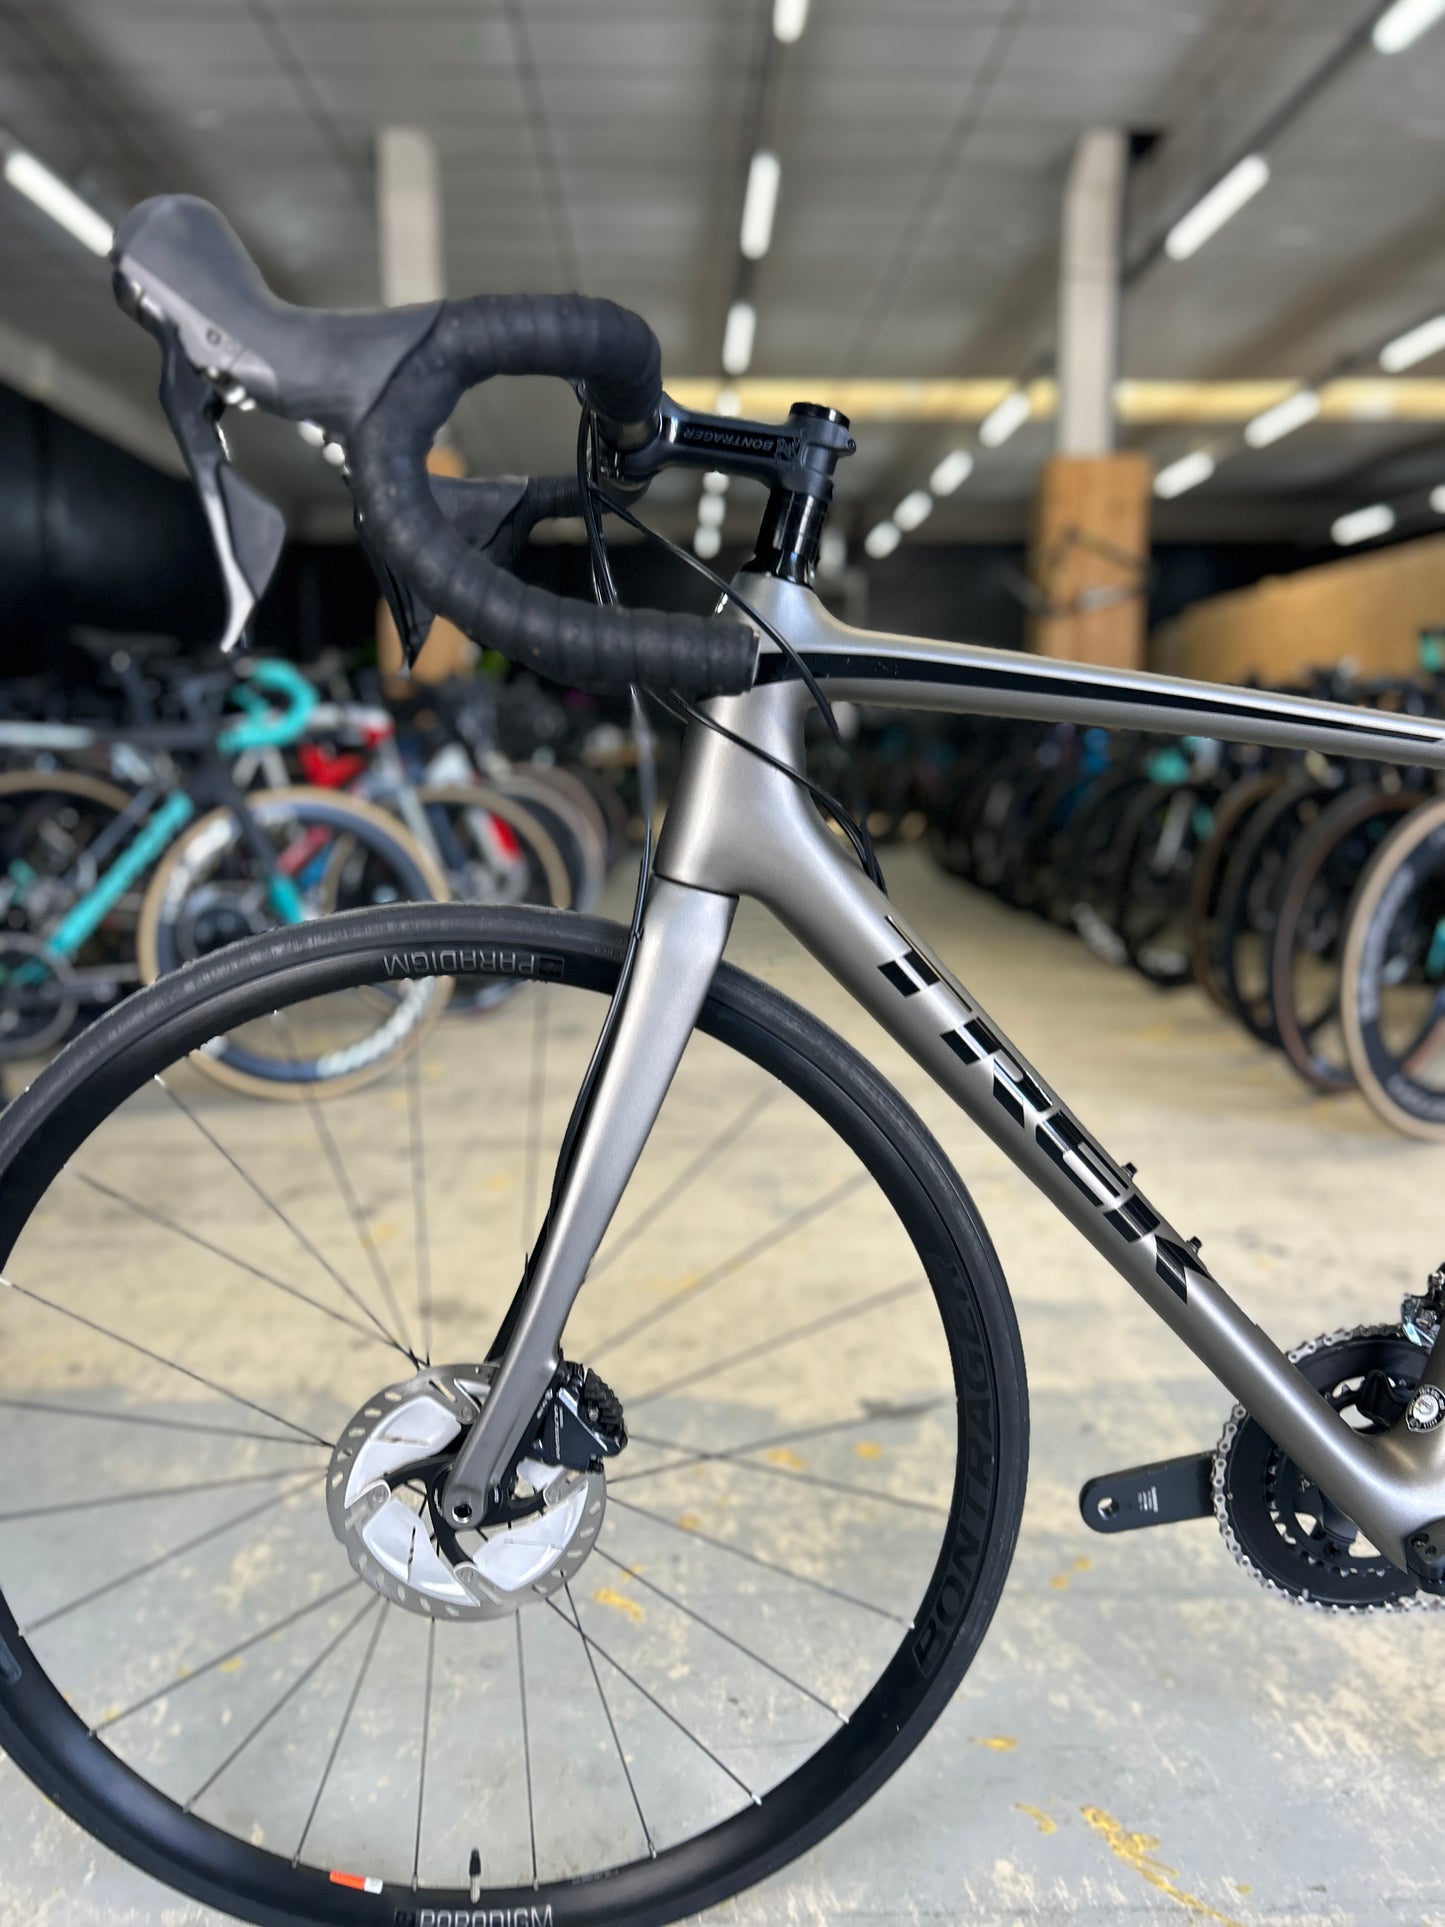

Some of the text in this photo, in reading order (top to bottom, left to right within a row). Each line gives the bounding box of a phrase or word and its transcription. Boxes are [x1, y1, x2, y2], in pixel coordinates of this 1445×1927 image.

[683, 427, 774, 450] BONTRAGER
[383, 950, 535, 977] PARADIGM
[877, 915, 1212, 1304] TREK
